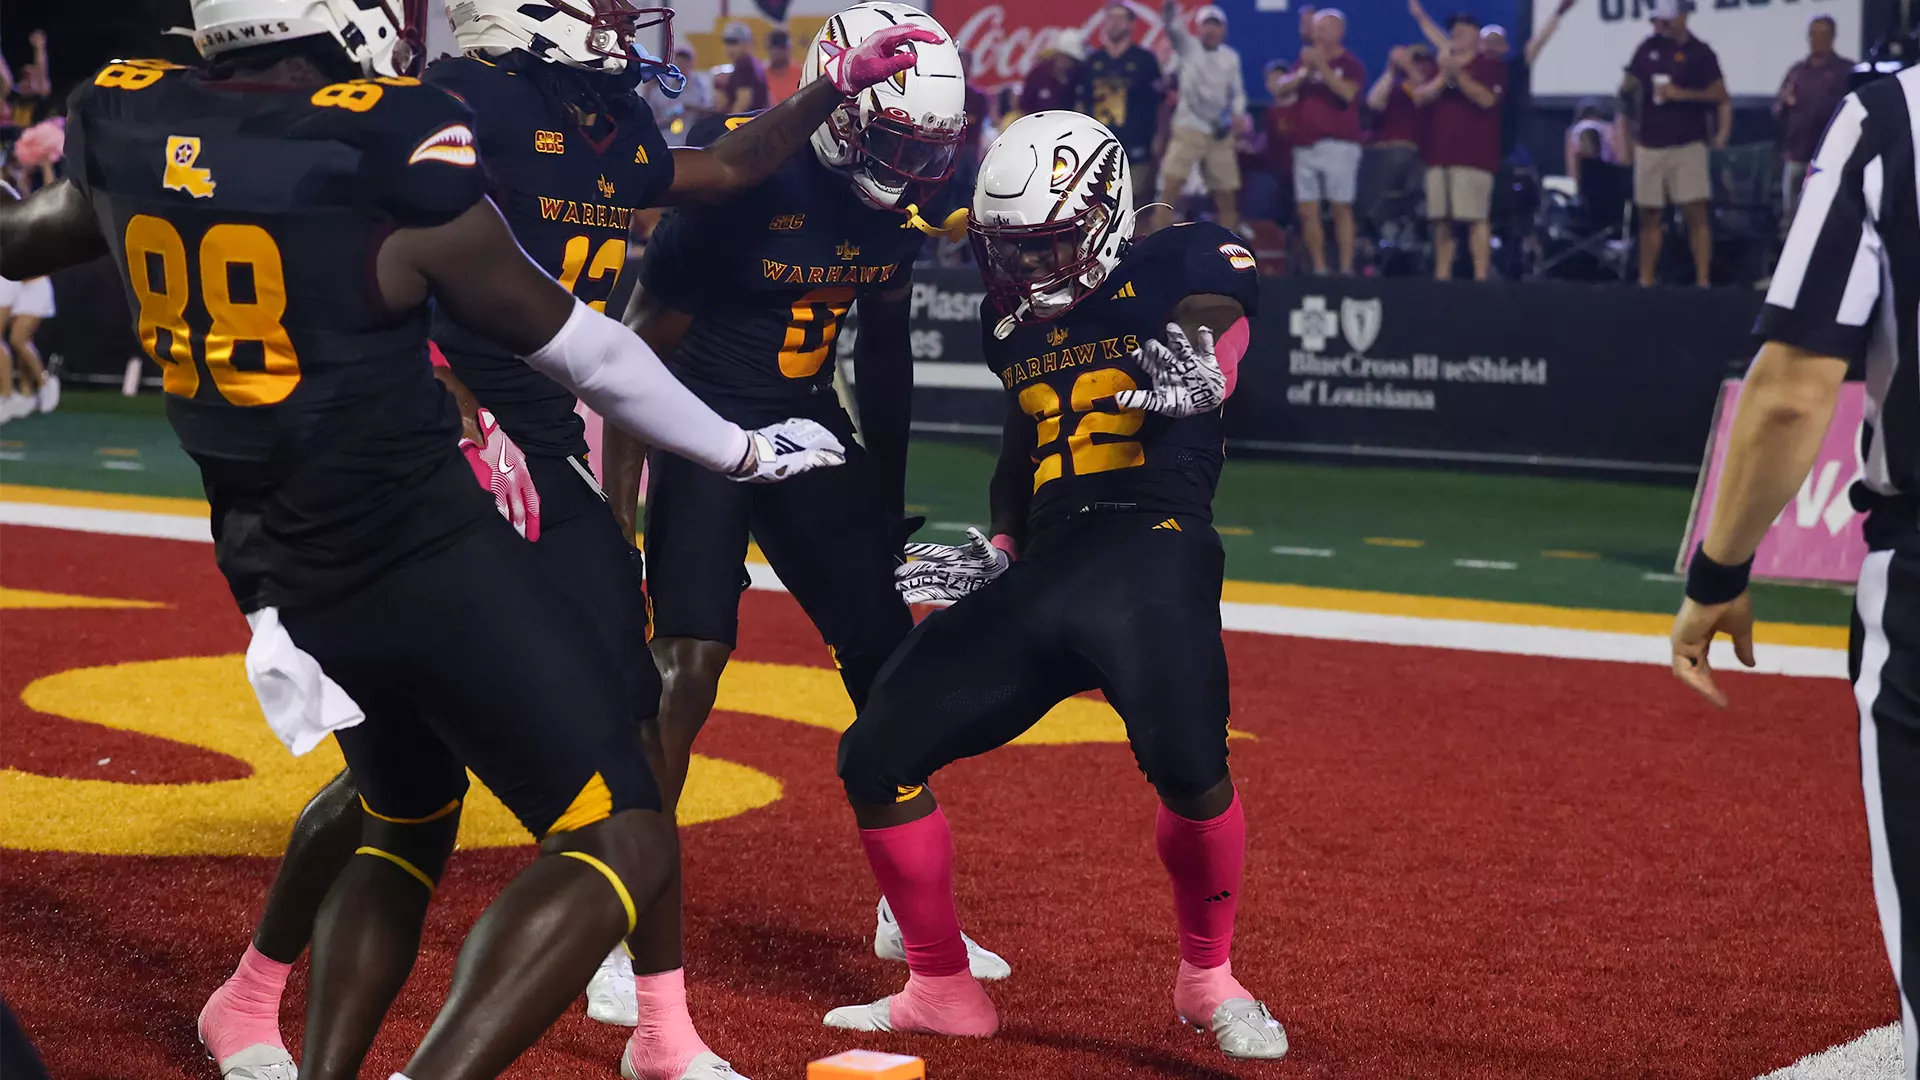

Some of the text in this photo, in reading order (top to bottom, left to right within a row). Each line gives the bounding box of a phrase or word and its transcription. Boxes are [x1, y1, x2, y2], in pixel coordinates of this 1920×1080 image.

[537, 196, 634, 230] WARHAW
[125, 213, 302, 407] 88
[1001, 334, 1141, 390] WARHAWKS
[1289, 350, 1547, 385] BlueCross BlueShield
[1286, 380, 1437, 412] of Louisiana
[1018, 366, 1146, 497] 22
